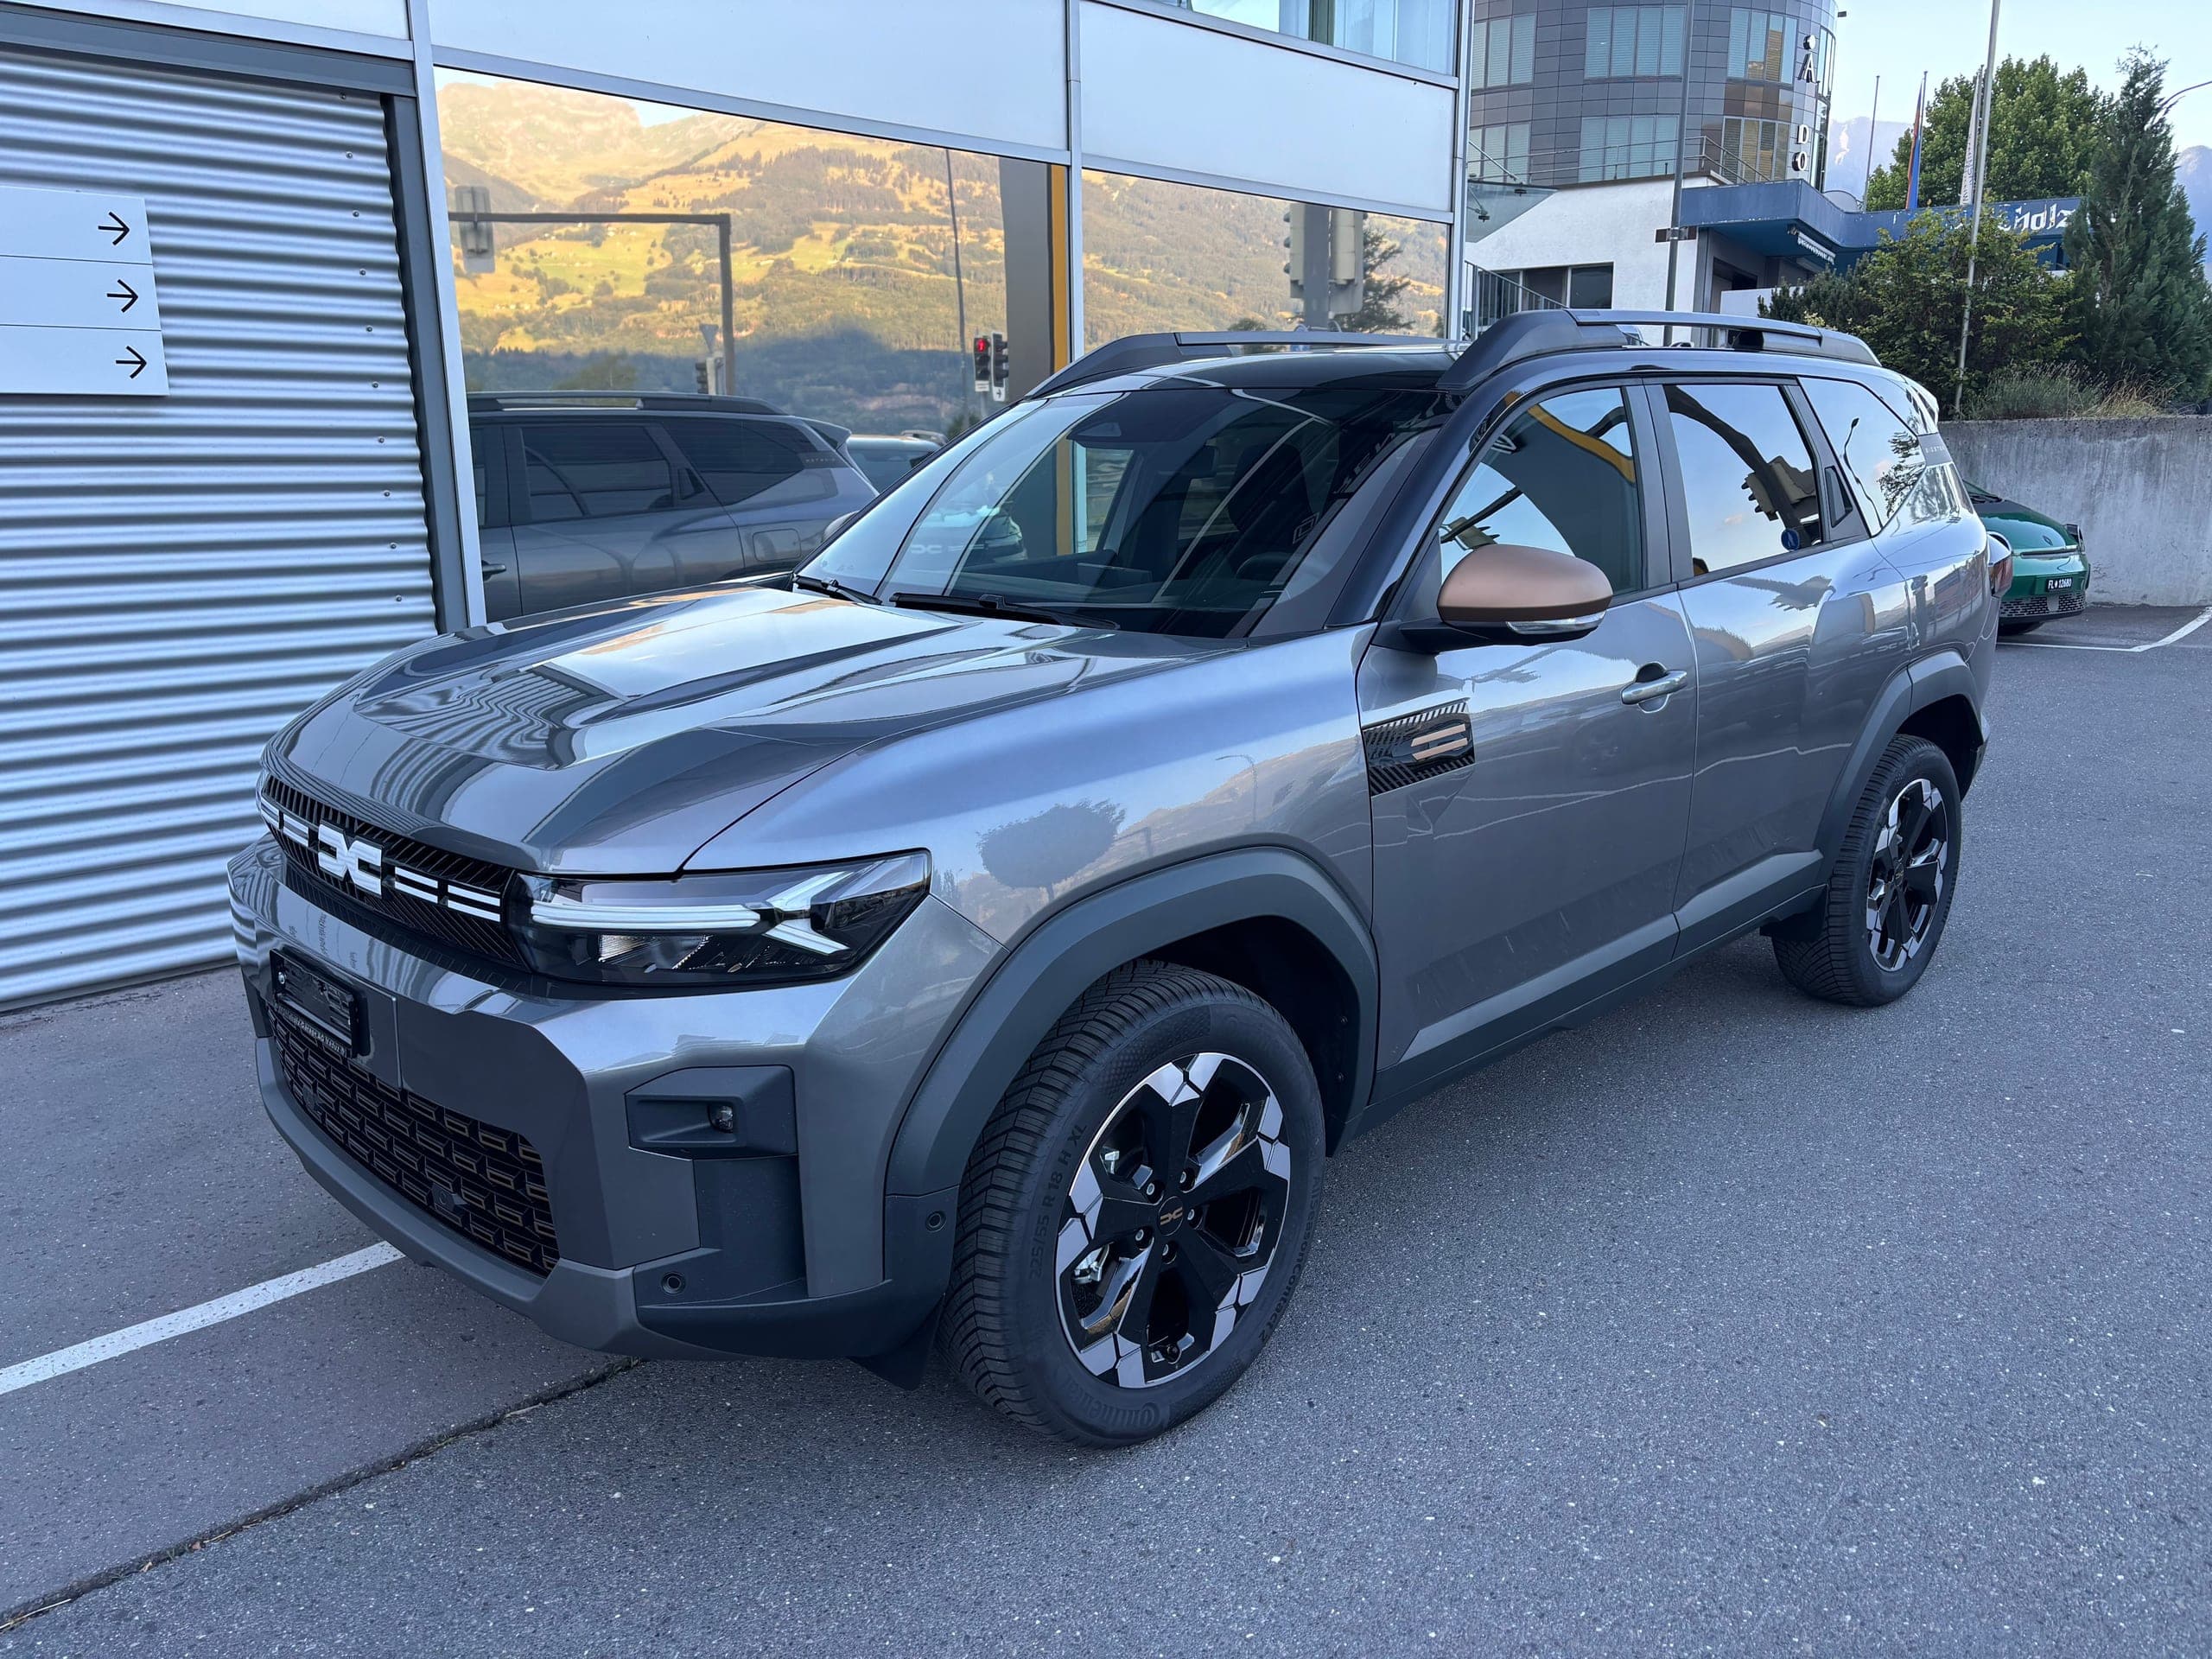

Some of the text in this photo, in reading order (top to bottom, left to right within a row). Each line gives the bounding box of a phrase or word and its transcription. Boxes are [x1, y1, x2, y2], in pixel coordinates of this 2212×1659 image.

[1029, 1123, 1088, 1281] 225/55 R 18 H XL
